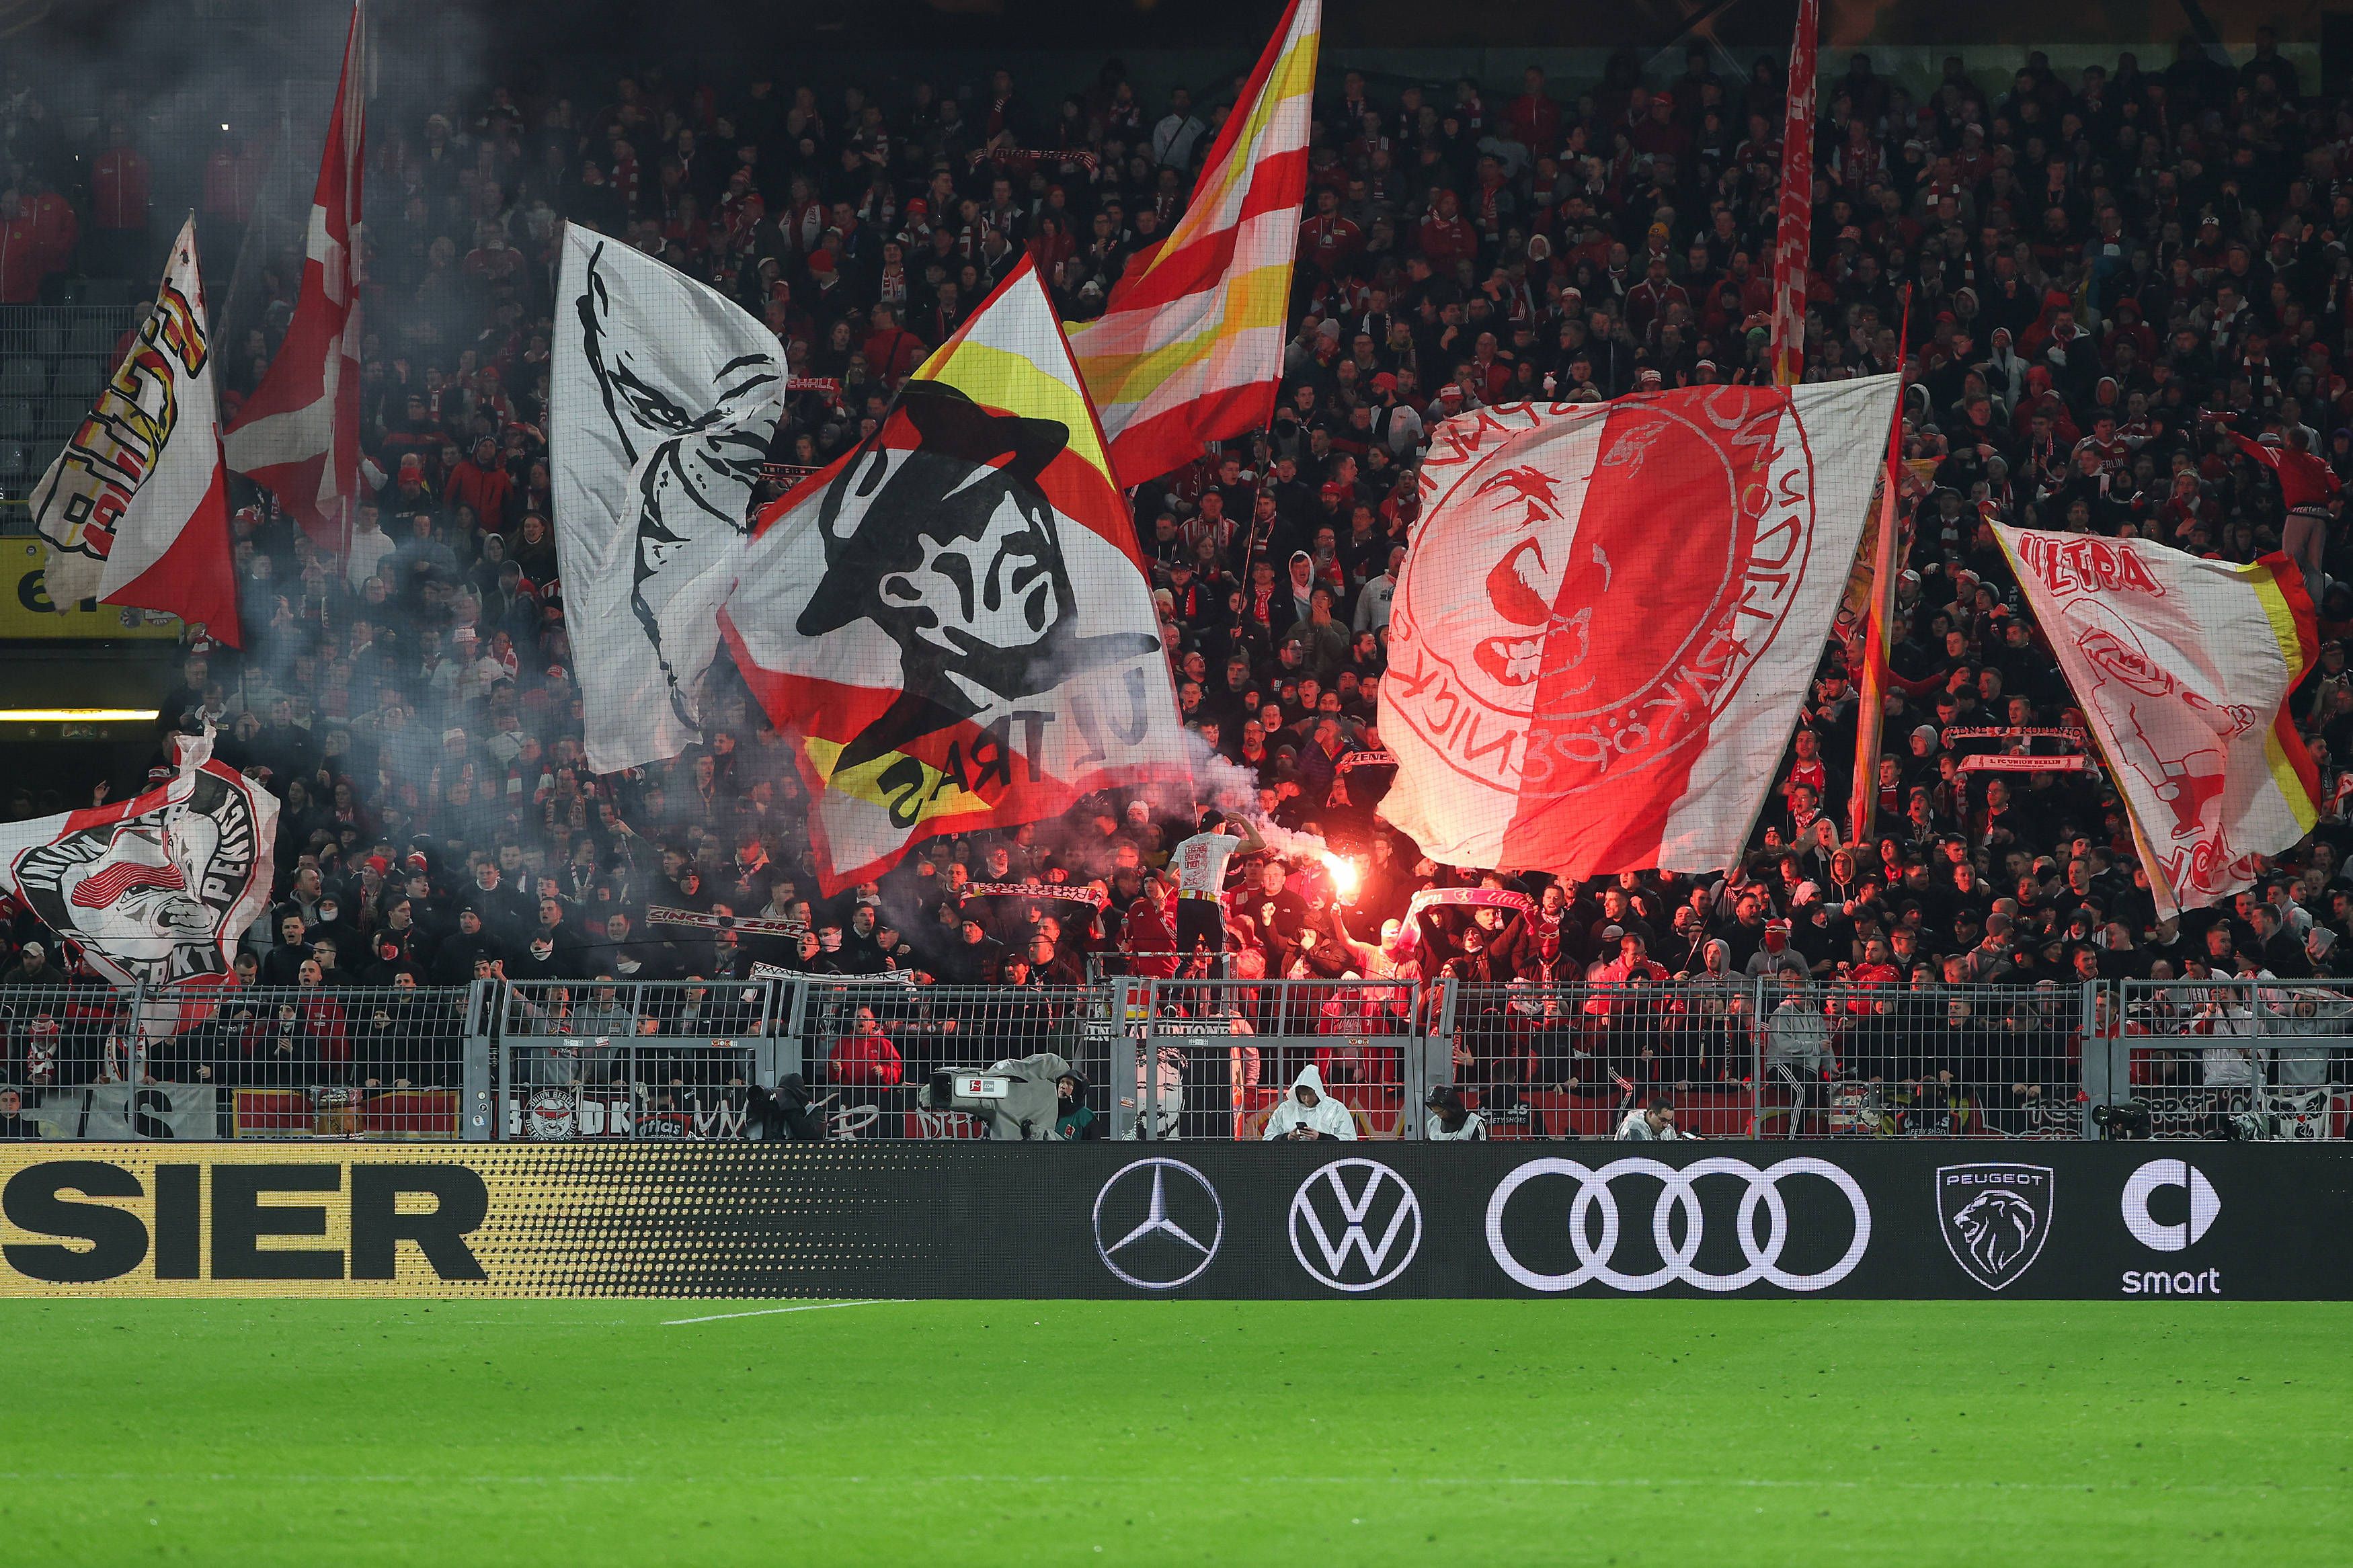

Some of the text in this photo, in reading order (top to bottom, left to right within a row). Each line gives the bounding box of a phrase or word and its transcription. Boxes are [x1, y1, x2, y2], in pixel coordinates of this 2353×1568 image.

[2101, 458, 2124, 468] ERLIN
[2018, 532, 2166, 597] ULTRA
[1949, 726, 1987, 735] ZENE
[1352, 753, 1388, 761] ZENE
[1487, 892, 1529, 906] Unio
[649, 911, 710, 923] SINCE
[1157, 1024, 1232, 1037] UNIONE
[530, 1091, 575, 1108] UNION BERLIN
[639, 1120, 681, 1137] atlas
[1946, 1173, 2043, 1186] PEUGEOT
[2, 1160, 489, 1282] SIER
[2121, 1268, 2221, 1294] smart
